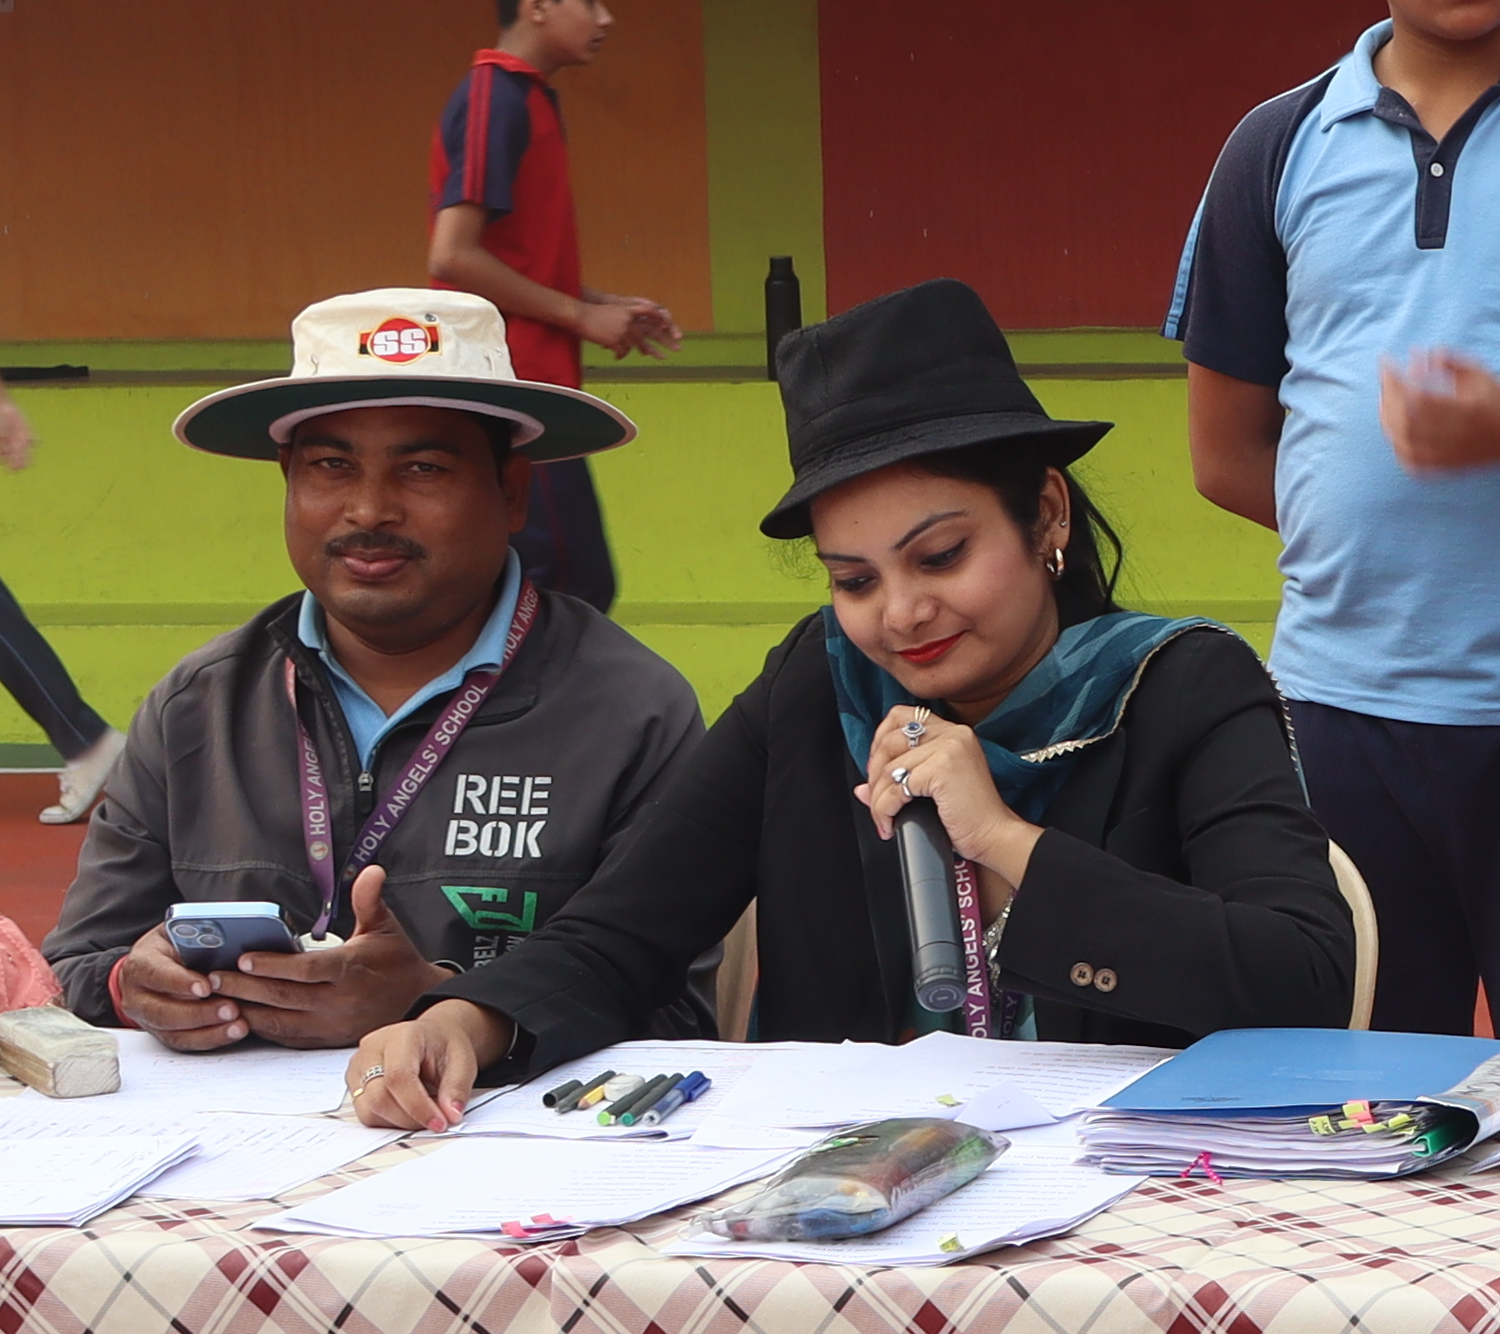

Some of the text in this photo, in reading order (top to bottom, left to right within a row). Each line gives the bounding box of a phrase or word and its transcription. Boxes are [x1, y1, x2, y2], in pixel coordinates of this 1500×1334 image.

[373, 327, 428, 356] SS
[354, 683, 489, 863] HOLY ANGELS' SCHOOL
[454, 773, 552, 815] REE
[308, 789, 327, 836] HOLY
[445, 819, 547, 858] BOK
